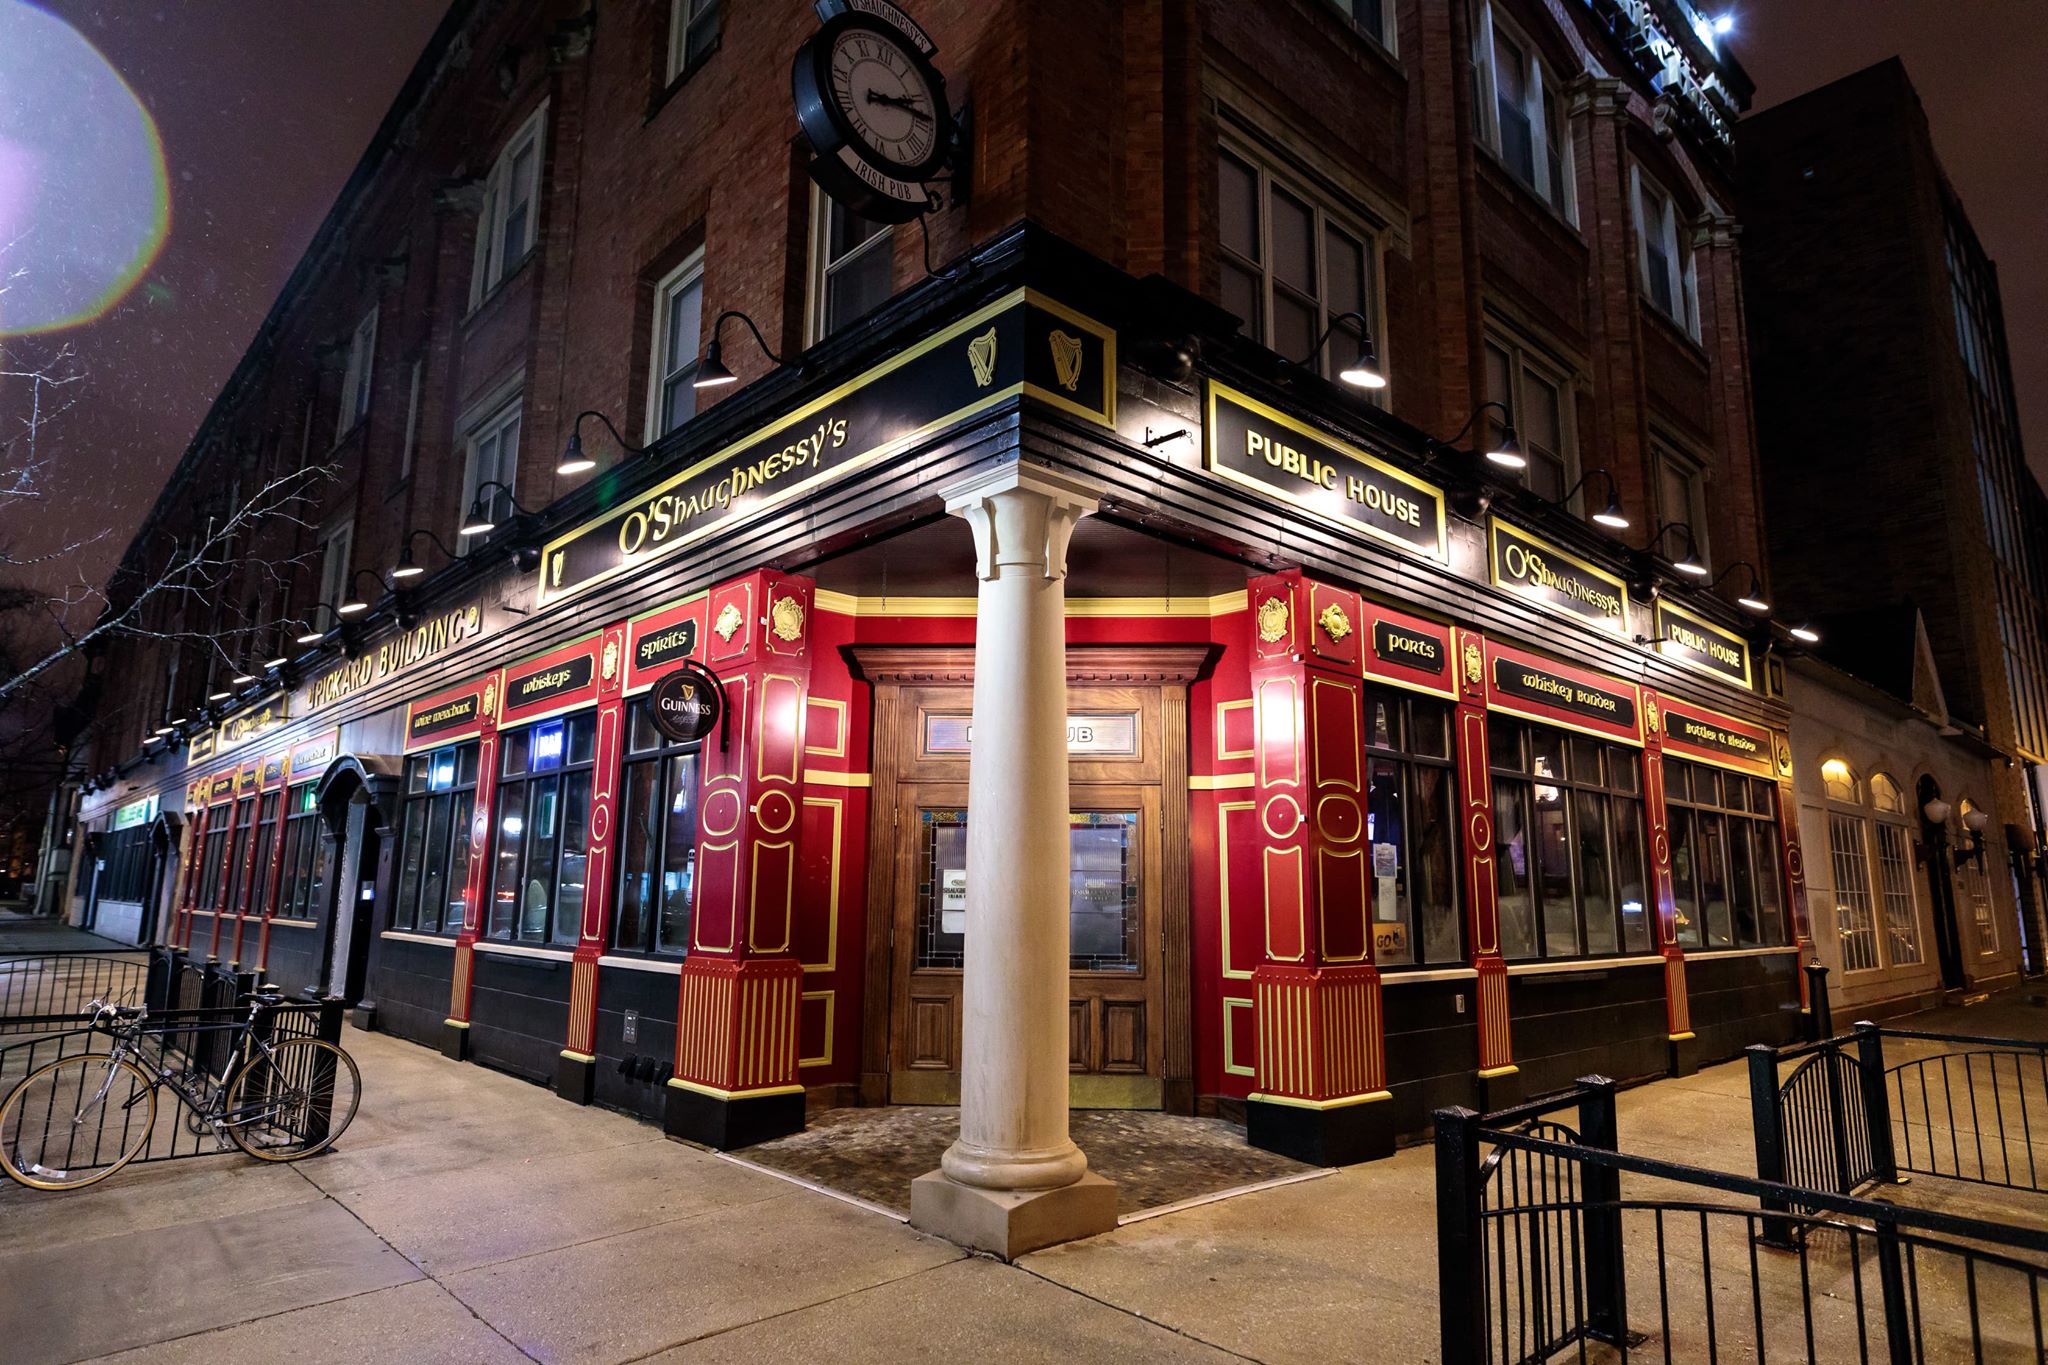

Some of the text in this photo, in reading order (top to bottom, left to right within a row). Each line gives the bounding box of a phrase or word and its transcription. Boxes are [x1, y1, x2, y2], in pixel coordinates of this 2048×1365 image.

[853, 0, 926, 49] OSHAUGHNESSY'S
[855, 40, 870, 57] XI
[855, 161, 912, 200] IRISH PUB
[1246, 429, 1421, 527] PUBLIC HOUSE
[315, 608, 465, 707] PICKARD BUILDING
[1670, 623, 1740, 668] PUBLIC HOUSE
